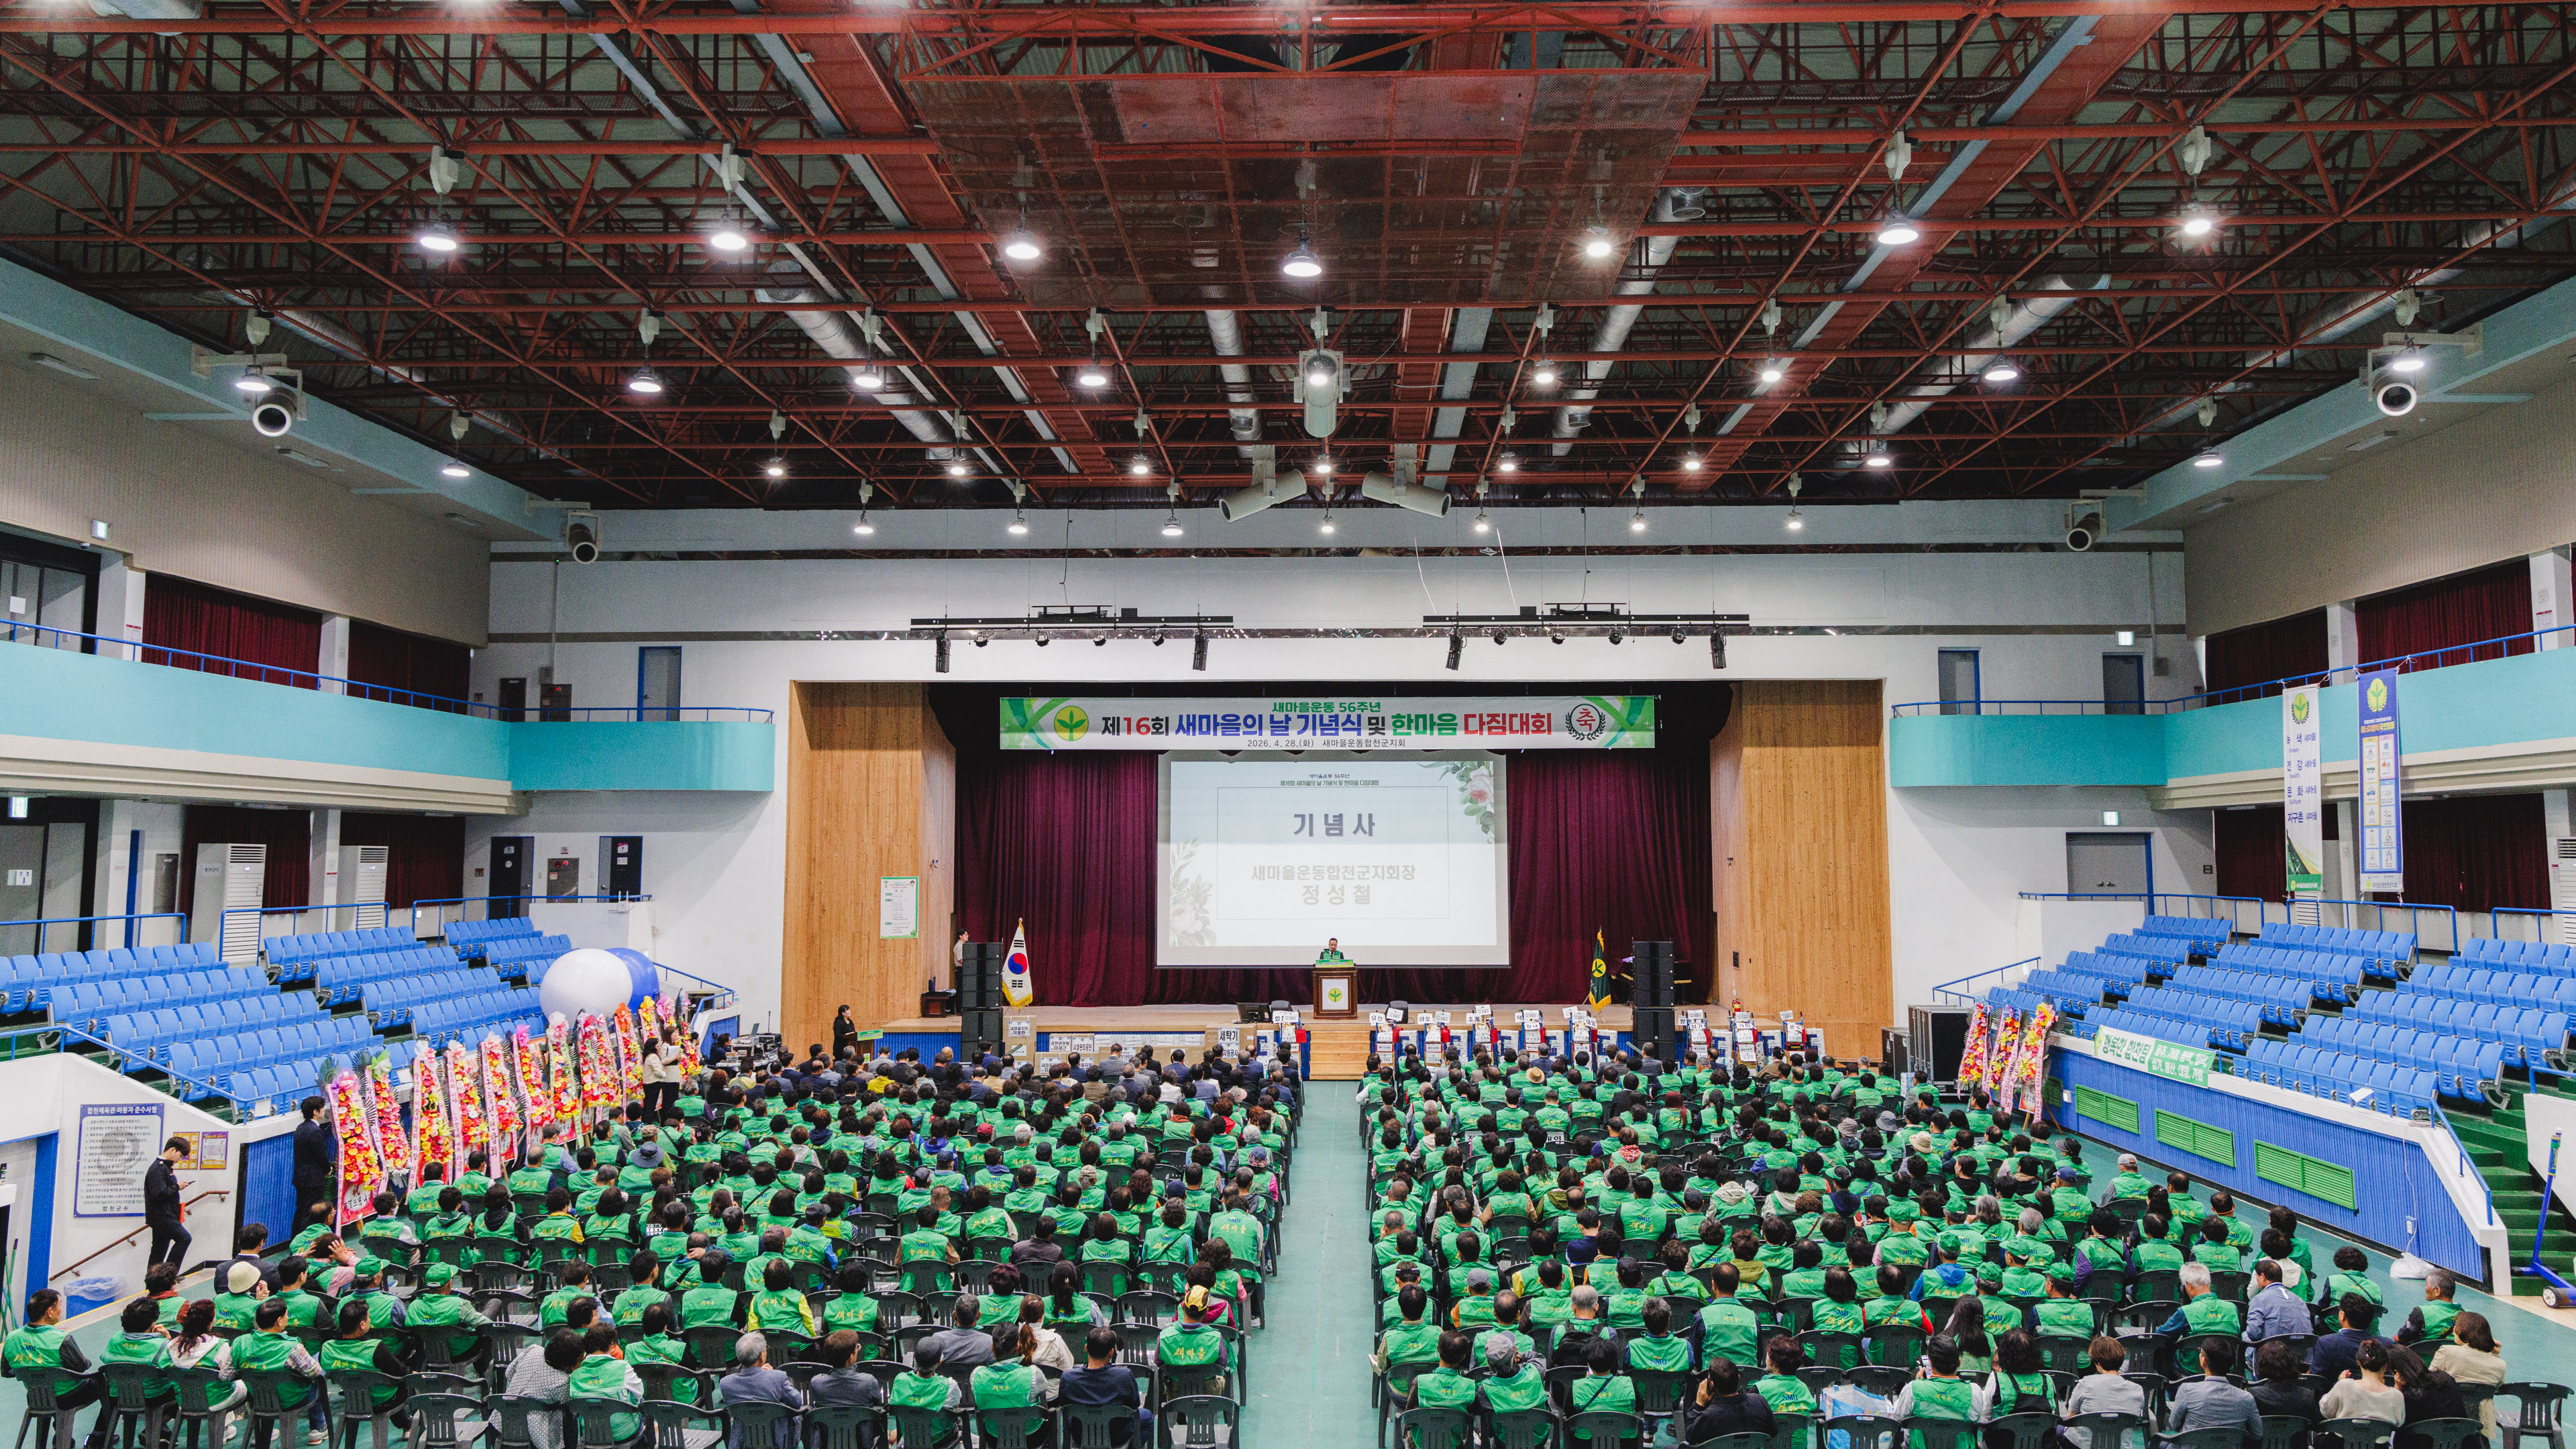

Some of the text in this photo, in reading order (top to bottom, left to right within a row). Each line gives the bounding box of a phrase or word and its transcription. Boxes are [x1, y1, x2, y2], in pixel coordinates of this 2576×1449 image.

[1272, 702, 1381, 712] 새마을운동 56주년
[1102, 712, 1552, 737] 제16회 새마을의 날 기념식 및 한마음 다짐대회
[1575, 708, 1597, 731] 축
[1247, 739, 1271, 748] 2026.
[1285, 739, 1313, 748] 28.(화)
[1322, 739, 1405, 747] 새마을운동합천군지회
[2288, 811, 2304, 824] 지구촌
[1251, 865, 1415, 881] 새마을운동합천군지회장
[1220, 1030, 1238, 1040] 세탁기
[1073, 1044, 1092, 1052] 시설관리공단
[2102, 1034, 2127, 1058] 행복한
[135, 1106, 158, 1114] 준수사항
[1220, 1224, 1246, 1233] 새마을
[1630, 1222, 1655, 1233] 새마을
[760, 1296, 788, 1307] 새마을
[835, 1309, 865, 1320] 새마을
[1825, 1316, 1854, 1329] 새마을
[1174, 1347, 1206, 1360] 새마을
